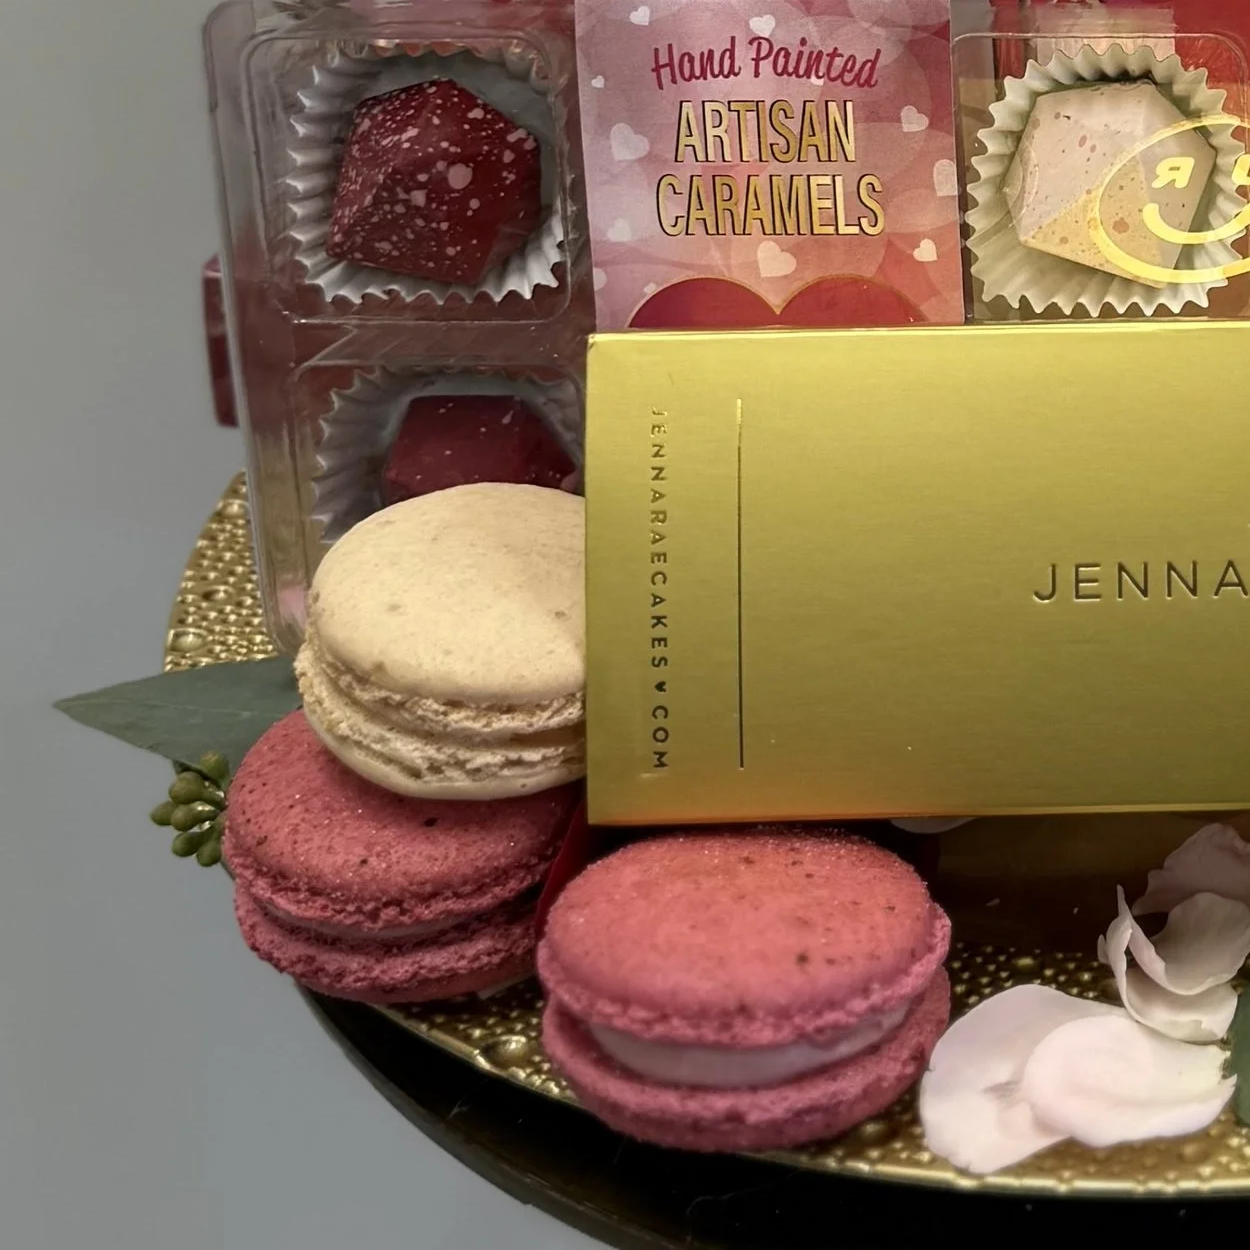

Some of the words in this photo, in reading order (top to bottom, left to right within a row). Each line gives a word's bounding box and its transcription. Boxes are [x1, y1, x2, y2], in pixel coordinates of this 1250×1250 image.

[651, 35, 742, 91] Hand
[748, 36, 882, 89] Painted
[674, 99, 857, 164] ARTISAN
[656, 173, 886, 237] CARAMELS
[1032, 559, 1250, 605] JENNA
